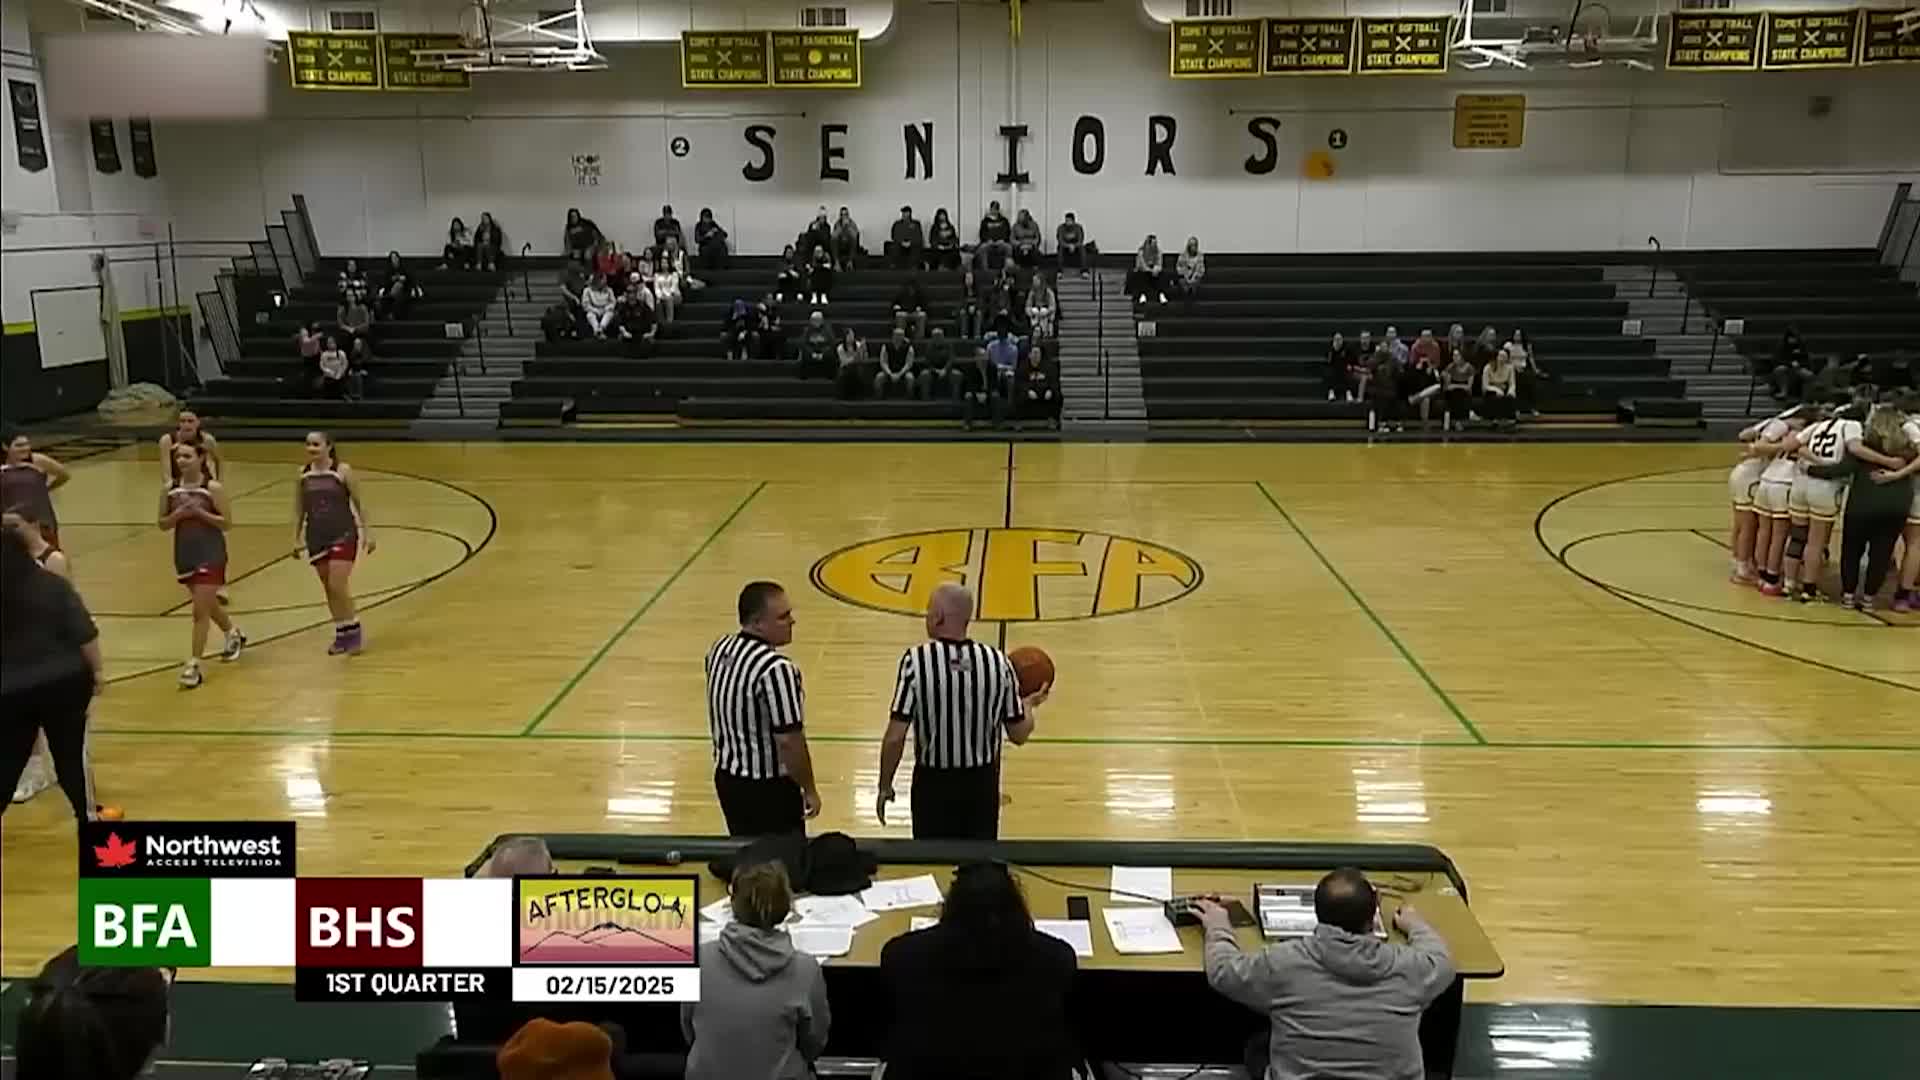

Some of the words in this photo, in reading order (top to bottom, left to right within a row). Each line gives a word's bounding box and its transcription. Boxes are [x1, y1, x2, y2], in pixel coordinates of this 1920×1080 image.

[1367, 23, 1395, 34] COMET
[1398, 22, 1441, 33] SOFTBALL
[1709, 18, 1753, 29] SOFTBALL
[1775, 18, 1802, 28] COMET
[1806, 17, 1849, 27] SOFTBALL
[1180, 25, 1207, 37] COMET
[1210, 24, 1252, 36] SOFTBALL
[1273, 23, 1301, 35] COMET
[1303, 23, 1345, 34] SOFTBALL
[803, 35, 854, 46] BASKETBALL
[1367, 54, 1392, 65] STATE
[1394, 53, 1440, 65] CHAMPIONS
[1675, 49, 1700, 61] STATE
[1703, 49, 1750, 61] CHAMPIONS
[1772, 48, 1797, 60] STATE
[1800, 47, 1847, 60] CHAMPIONS
[1179, 57, 1206, 70] STATE
[1208, 57, 1252, 69] CHAMPIONS
[1272, 54, 1298, 66] STATE
[1301, 54, 1345, 66] CHAMPIONS
[300, 70, 325, 82] STATE
[327, 70, 372, 82] CHAMPIONS
[690, 69, 715, 80] STATE
[717, 69, 762, 80] CHAMPIONS
[779, 69, 805, 80] STATE
[808, 69, 852, 80] CHAMPIONS
[742, 115, 1281, 184] SENIORS
[573, 165, 601, 176] THERE
[1811, 432, 1836, 457] 22
[809, 527, 1204, 622] BFA
